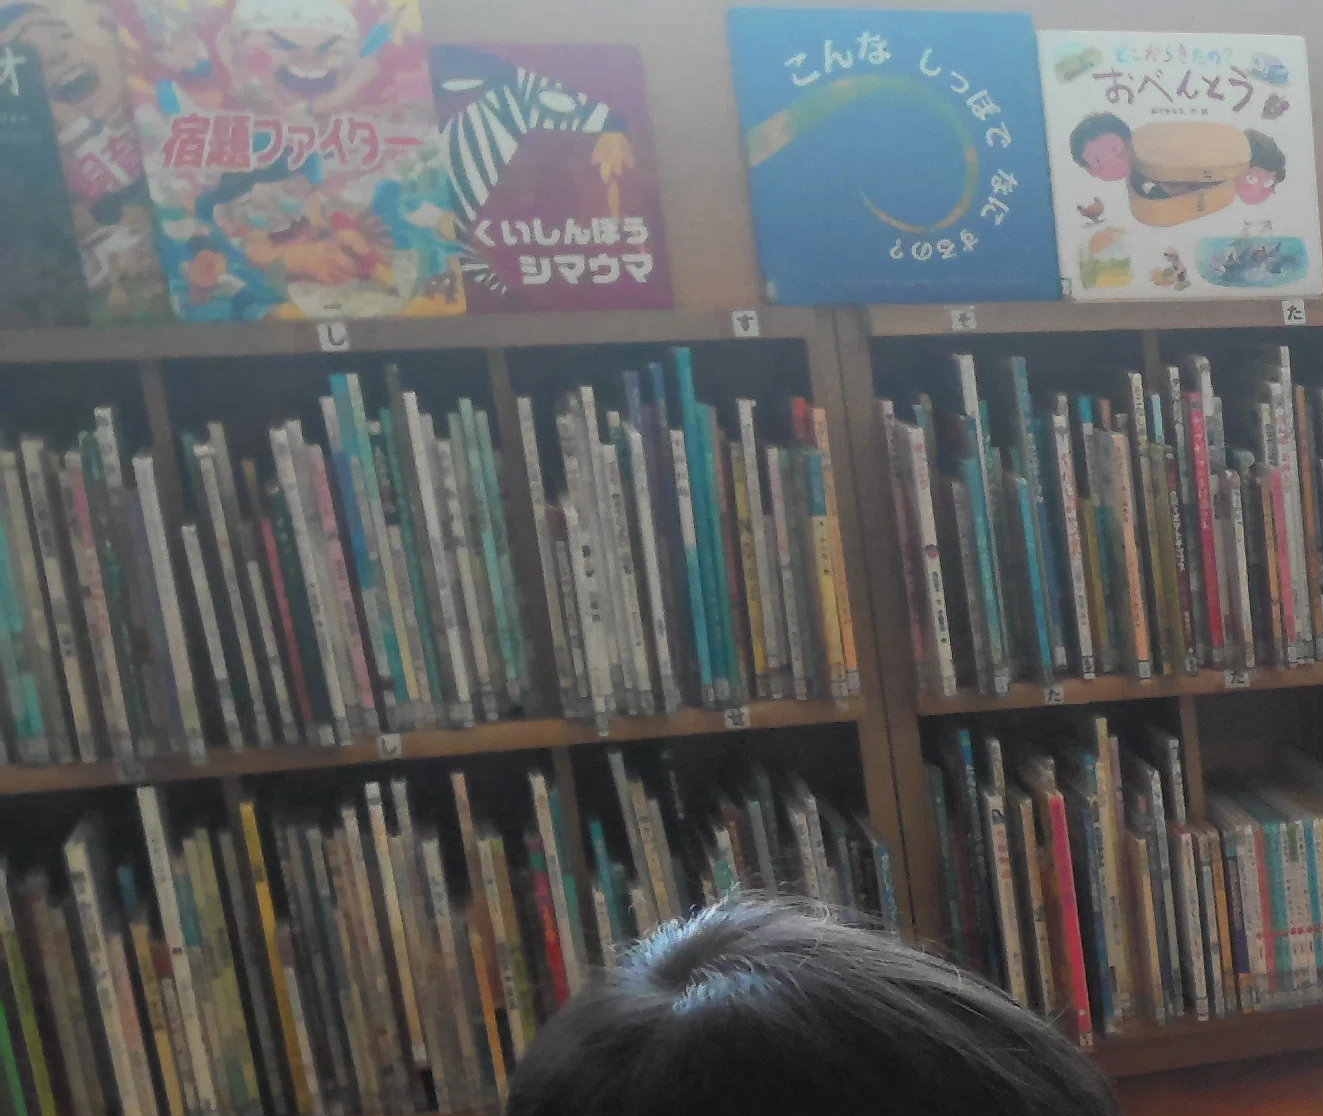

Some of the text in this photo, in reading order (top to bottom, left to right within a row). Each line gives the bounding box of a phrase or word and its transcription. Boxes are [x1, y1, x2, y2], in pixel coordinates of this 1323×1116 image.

[785, 31, 1013, 149] こんな しっぽで
[1092, 65, 1255, 112] おべんとう
[162, 113, 424, 170] 宿題ファイター
[518, 254, 653, 286] シマウマ
[1286, 303, 1304, 322] た
